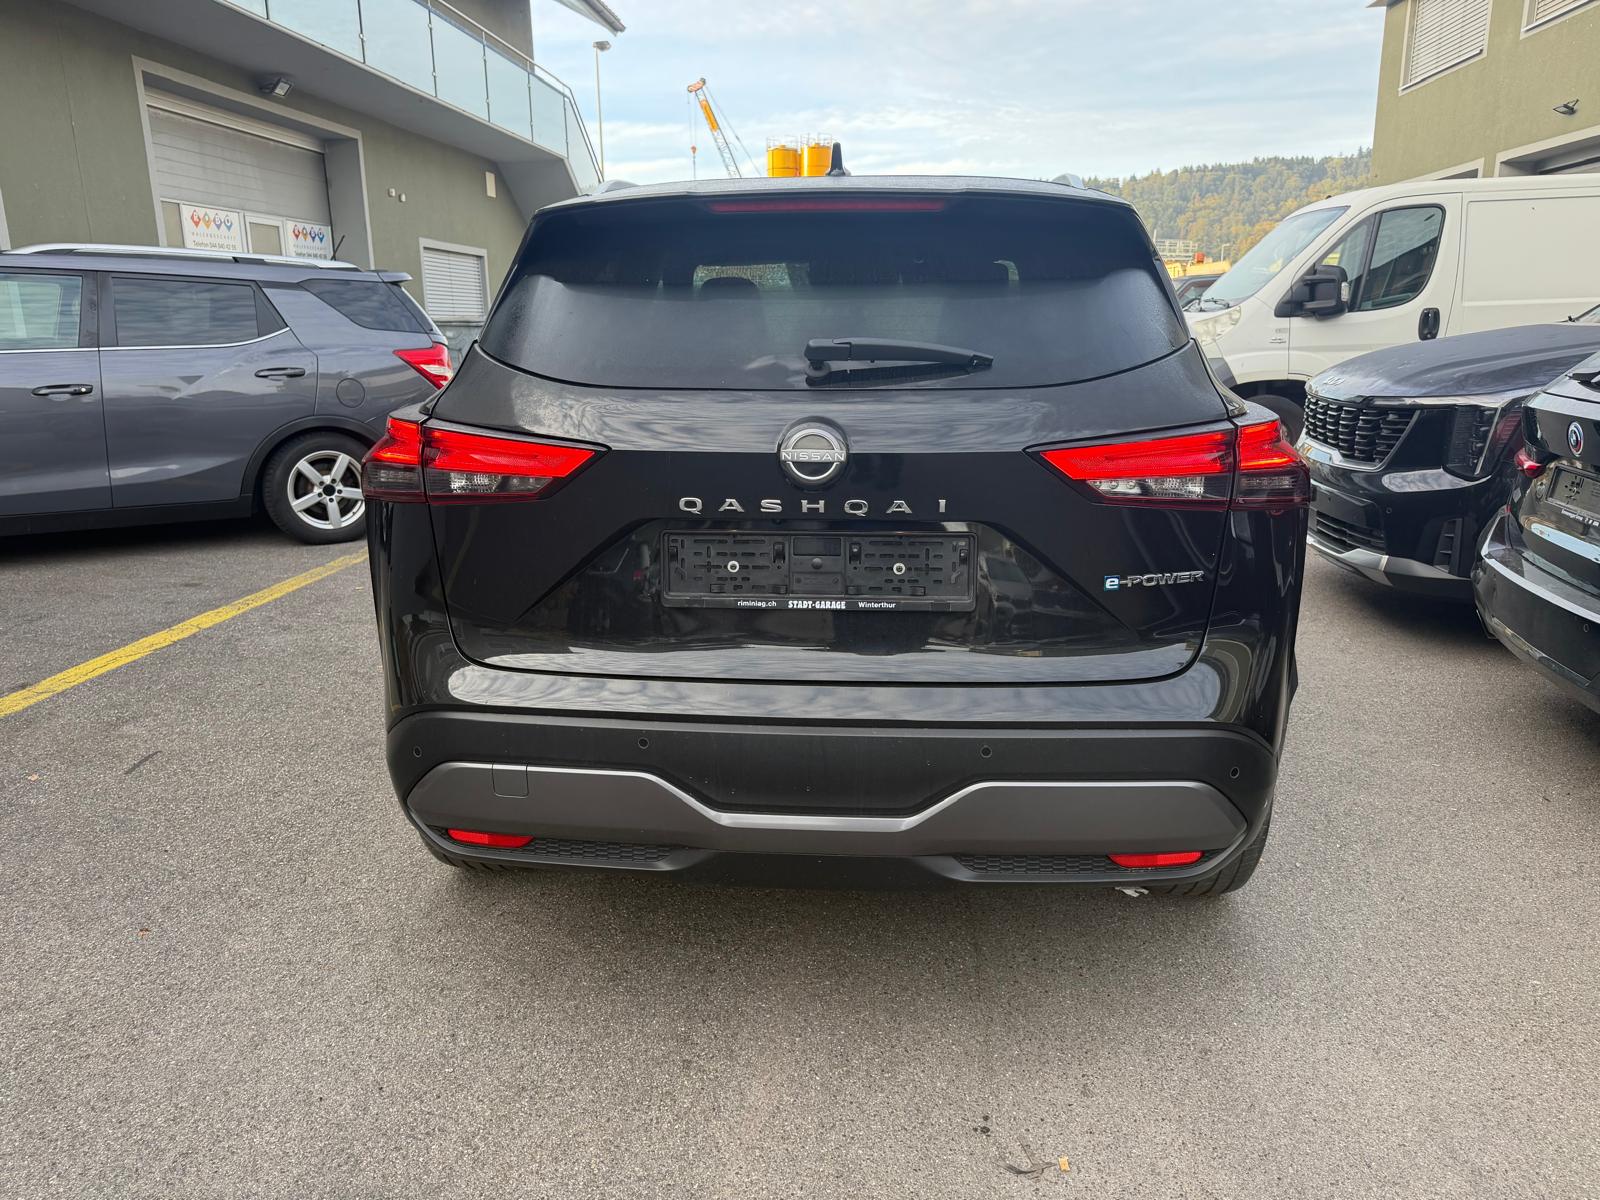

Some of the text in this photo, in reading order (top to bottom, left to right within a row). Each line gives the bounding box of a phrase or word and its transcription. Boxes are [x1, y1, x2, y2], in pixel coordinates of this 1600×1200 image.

[782, 452, 845, 461] NISSAN
[679, 497, 947, 517] QASHQAI
[737, 600, 777, 608] riminiag.ch
[858, 601, 897, 609] Winterthur
